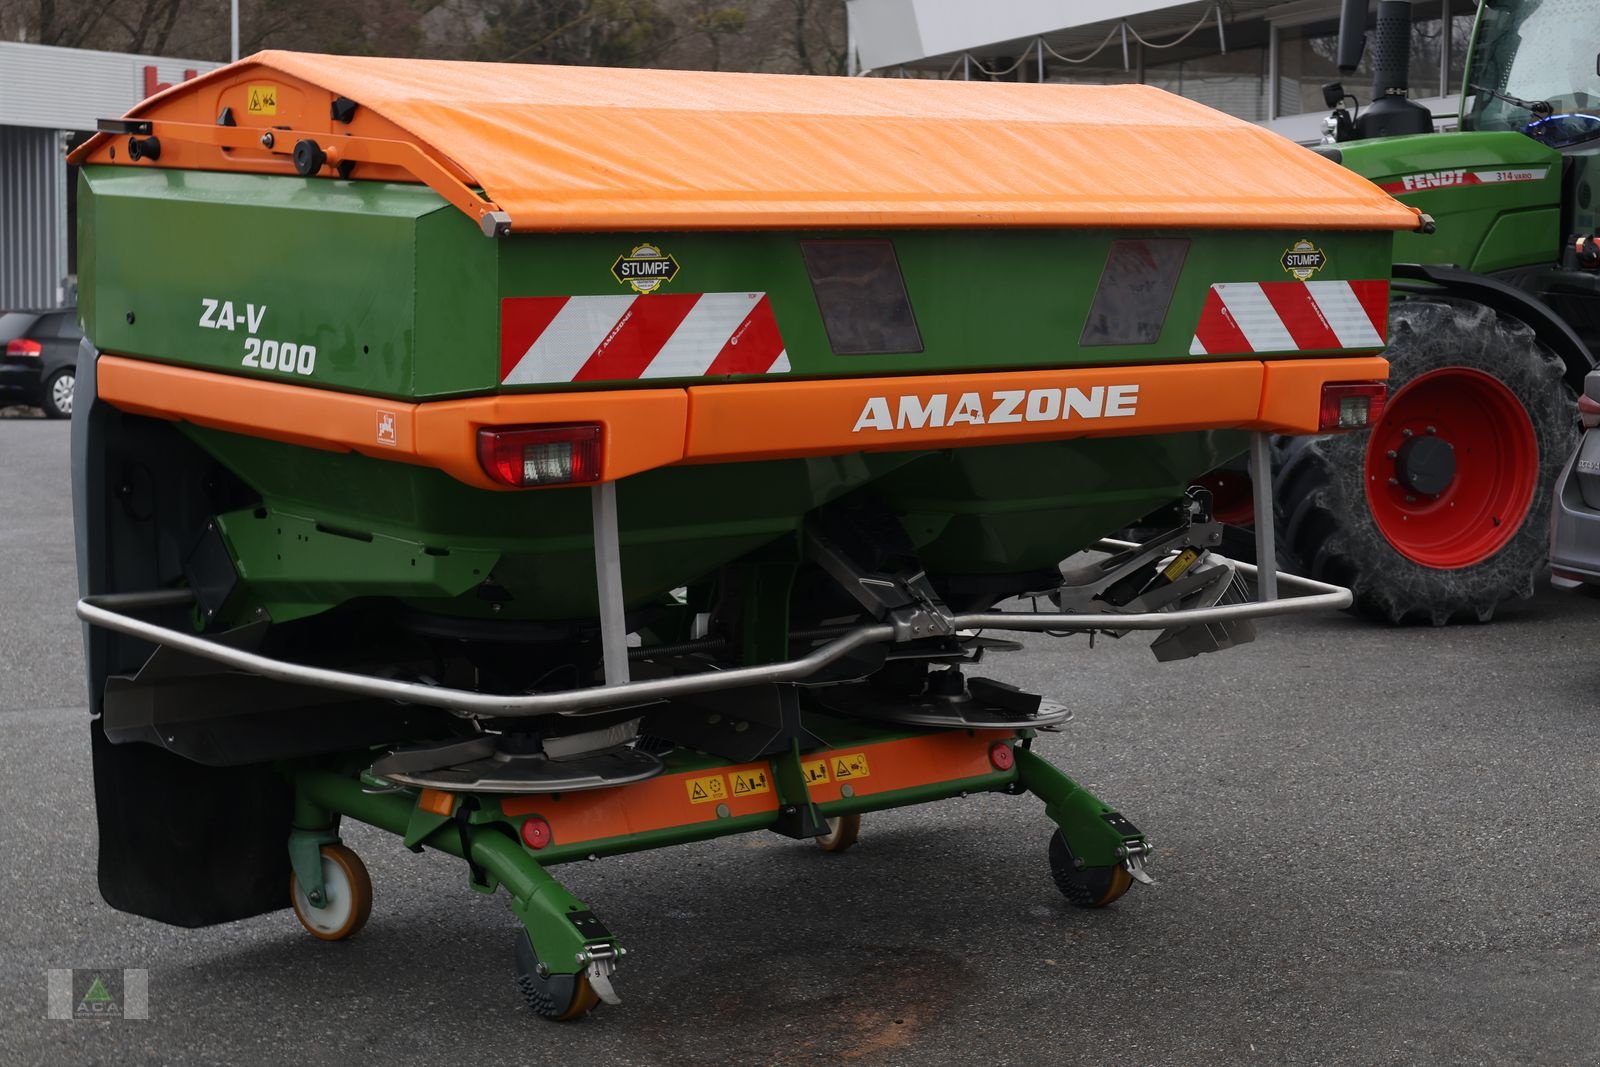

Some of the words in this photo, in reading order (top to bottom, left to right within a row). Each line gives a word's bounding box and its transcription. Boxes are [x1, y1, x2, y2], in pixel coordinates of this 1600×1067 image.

[1402, 169, 1467, 190] FENDT
[1497, 171, 1512, 181] 314
[1514, 172, 1532, 180] VARIO
[621, 261, 670, 276] STUMPF
[1287, 254, 1320, 266] STUMPF
[199, 298, 266, 333] ZA-V
[603, 310, 632, 348] AMAZONE
[241, 337, 316, 375] 2000
[852, 384, 1139, 432] AMAZONE
